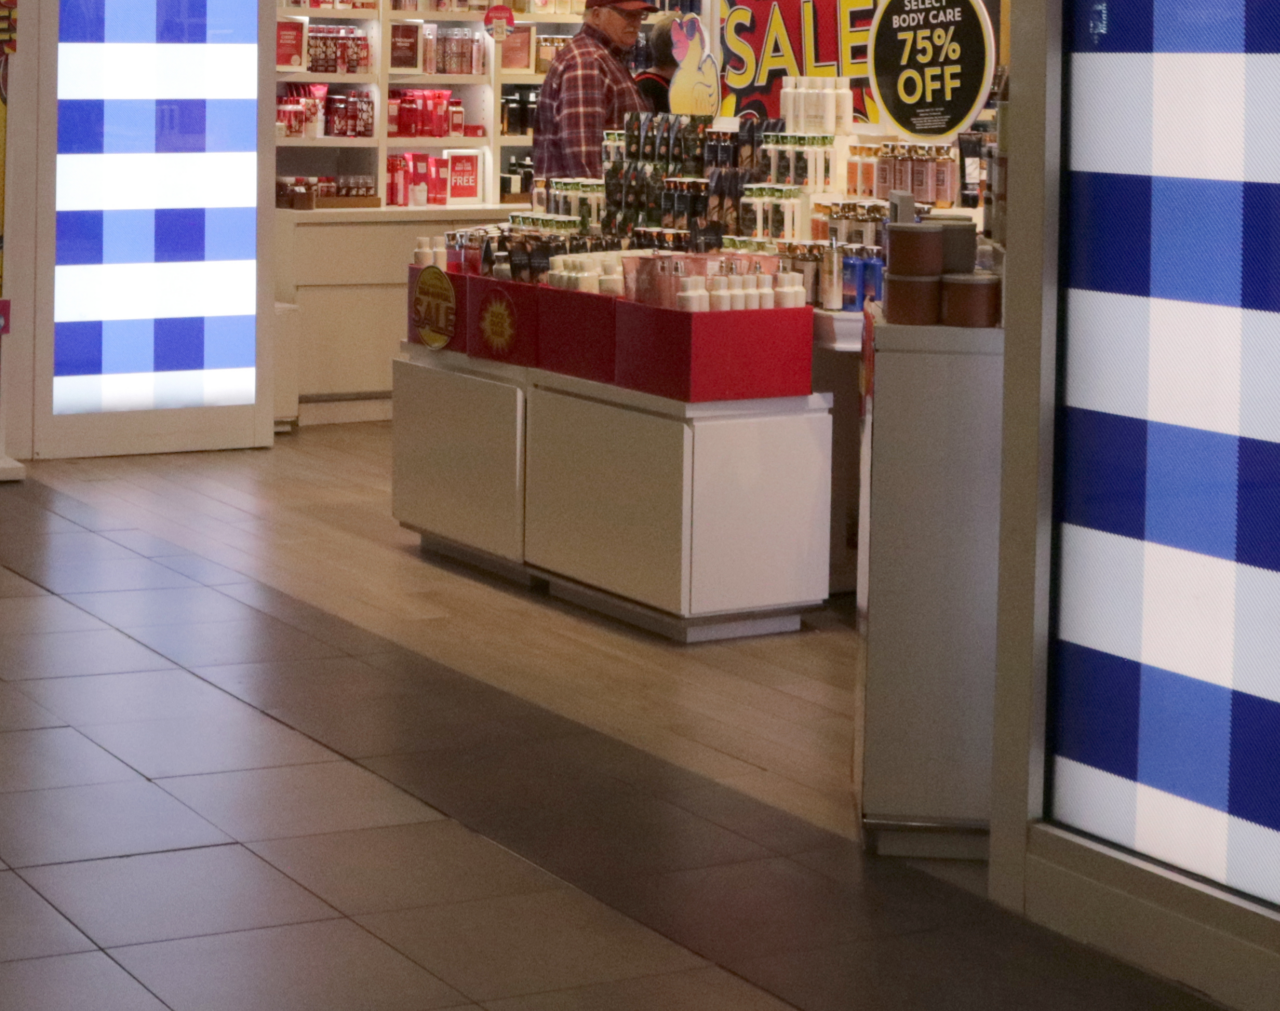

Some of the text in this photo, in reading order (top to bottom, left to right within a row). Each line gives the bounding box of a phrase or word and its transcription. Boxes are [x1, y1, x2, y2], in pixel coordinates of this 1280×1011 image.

[892, 7, 962, 28] BODY CARE
[896, 25, 962, 66] 75%
[896, 65, 962, 105] OFF
[451, 175, 476, 187] FREE
[412, 296, 456, 337] SALE
